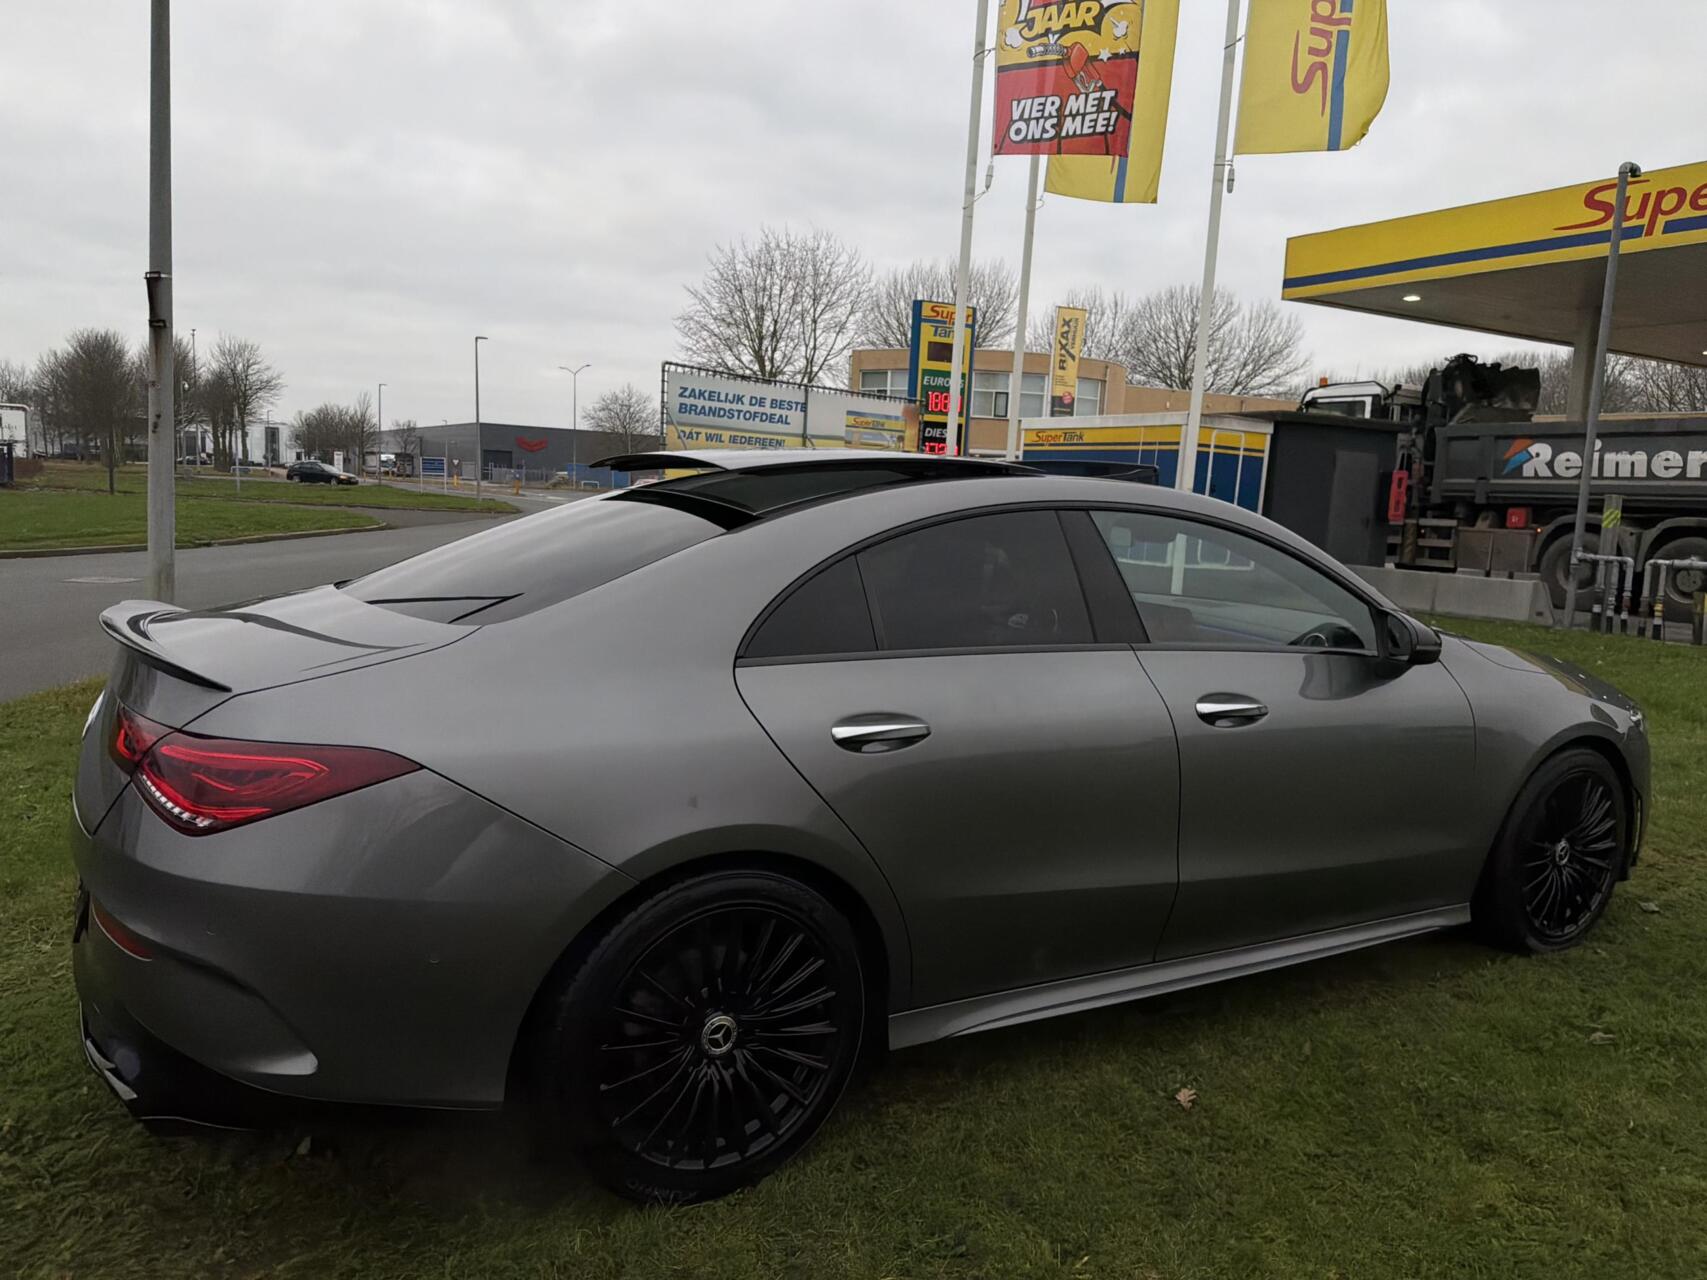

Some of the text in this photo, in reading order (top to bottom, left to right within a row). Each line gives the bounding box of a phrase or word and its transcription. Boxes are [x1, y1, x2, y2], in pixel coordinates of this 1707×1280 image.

[1020, 0, 1101, 38] JAAR
[1012, 90, 1116, 120] VIER MET
[1009, 111, 1118, 142] ONS MEE!
[678, 386, 808, 413] ZAKELIJK DE BESTE
[678, 402, 791, 426] BRANDSTOFDEAL
[704, 431, 726, 444] WIL
[1031, 430, 1085, 447] SuperTank
